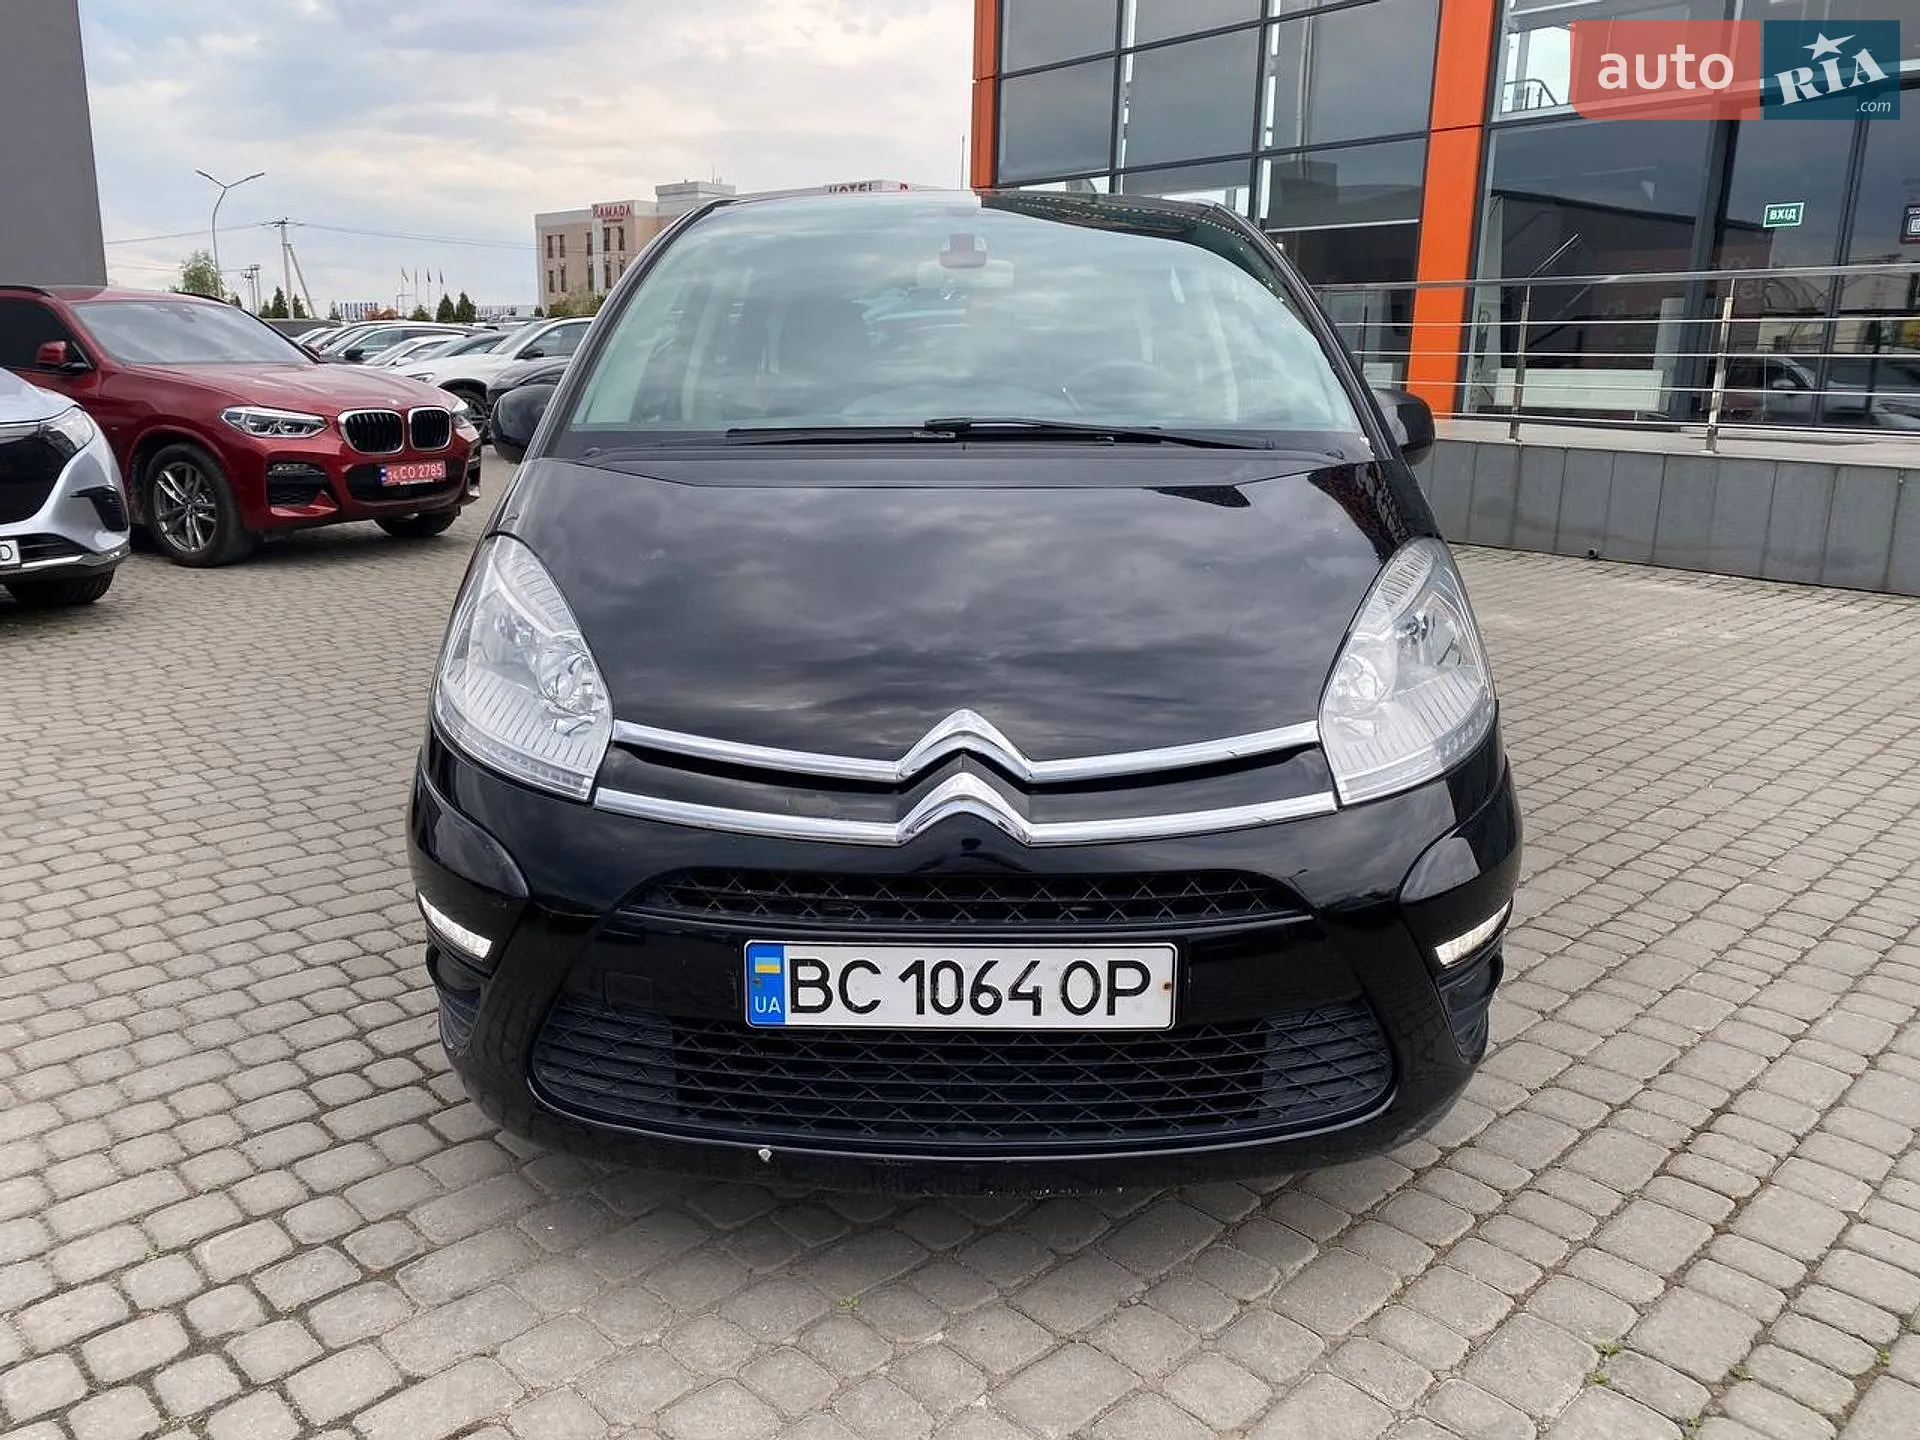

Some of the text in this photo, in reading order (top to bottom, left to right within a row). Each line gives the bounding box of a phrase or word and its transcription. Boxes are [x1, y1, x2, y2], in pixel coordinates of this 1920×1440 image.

[592, 203, 632, 217] RAMADA
[789, 958, 1152, 1016] BC 1064 OP
[755, 995, 781, 1013] UA
